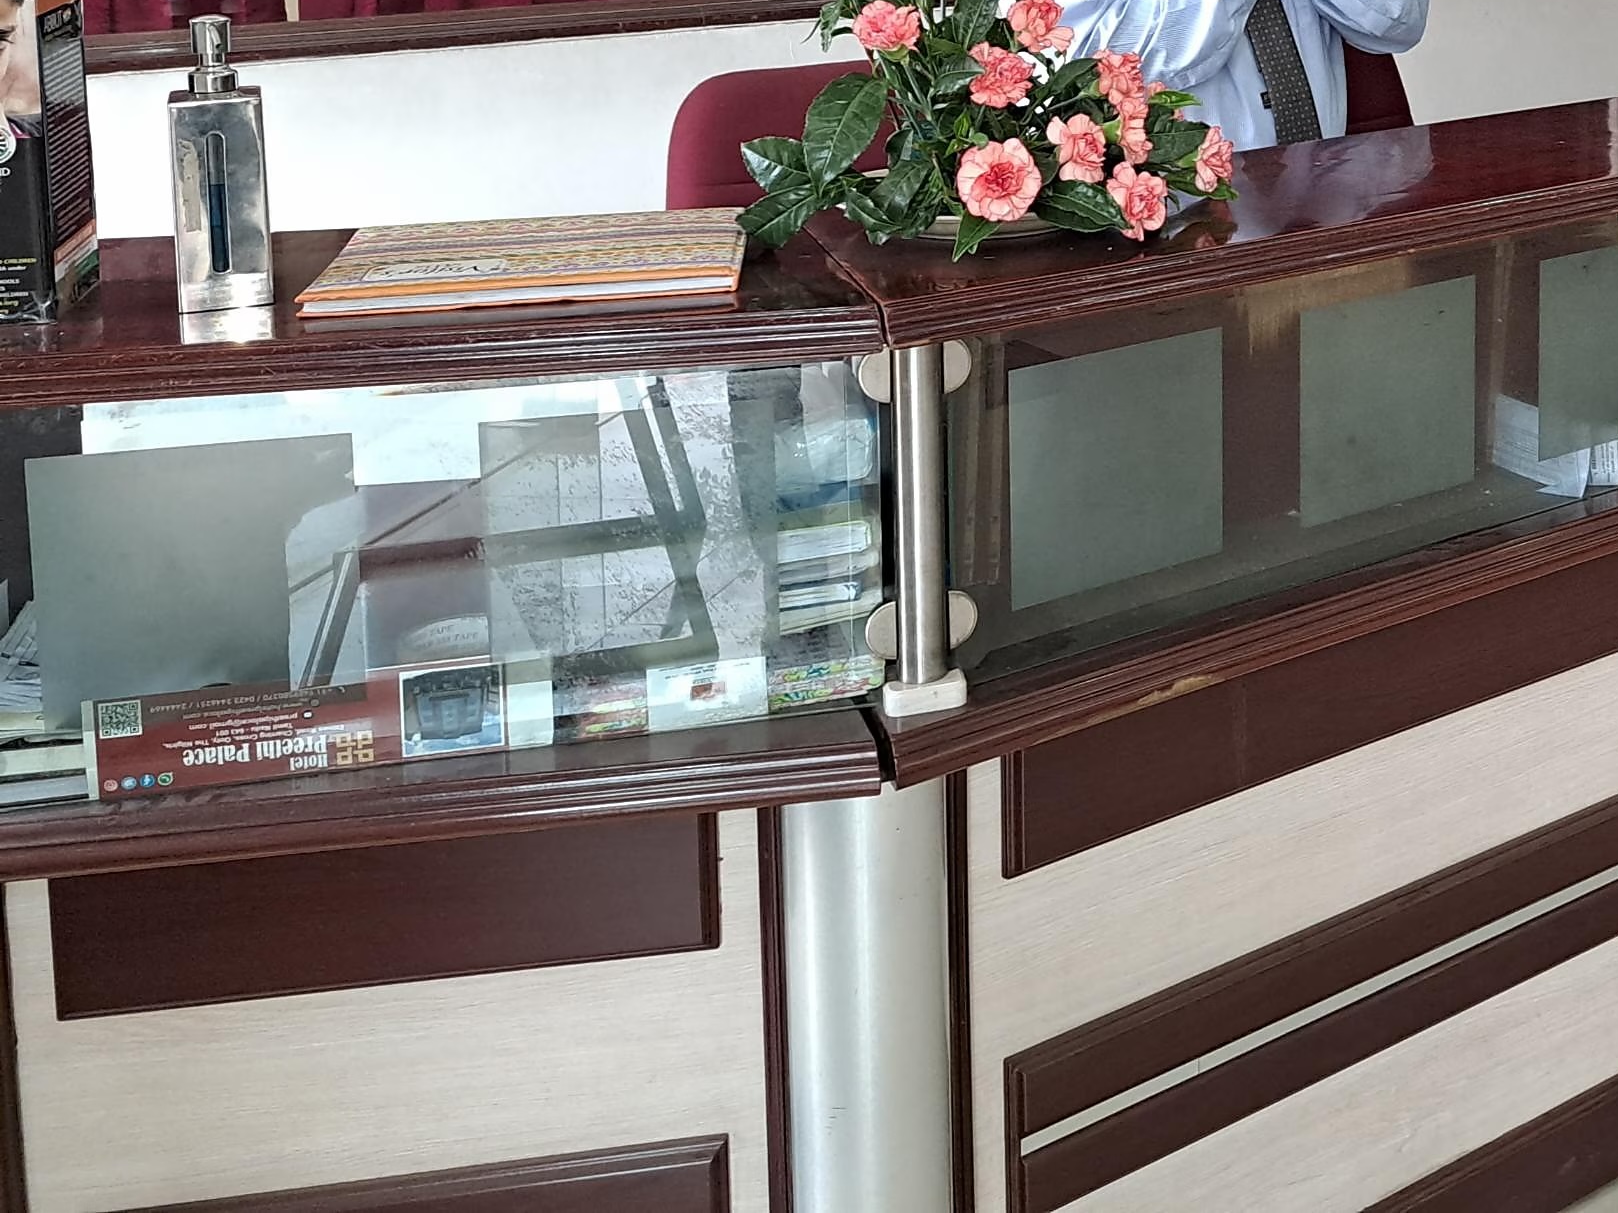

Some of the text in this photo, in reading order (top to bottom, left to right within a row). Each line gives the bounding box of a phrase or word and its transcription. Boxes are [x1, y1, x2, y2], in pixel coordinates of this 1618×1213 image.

[183, 734, 329, 767] Preethi Palace
[290, 752, 329, 771] Hotel
